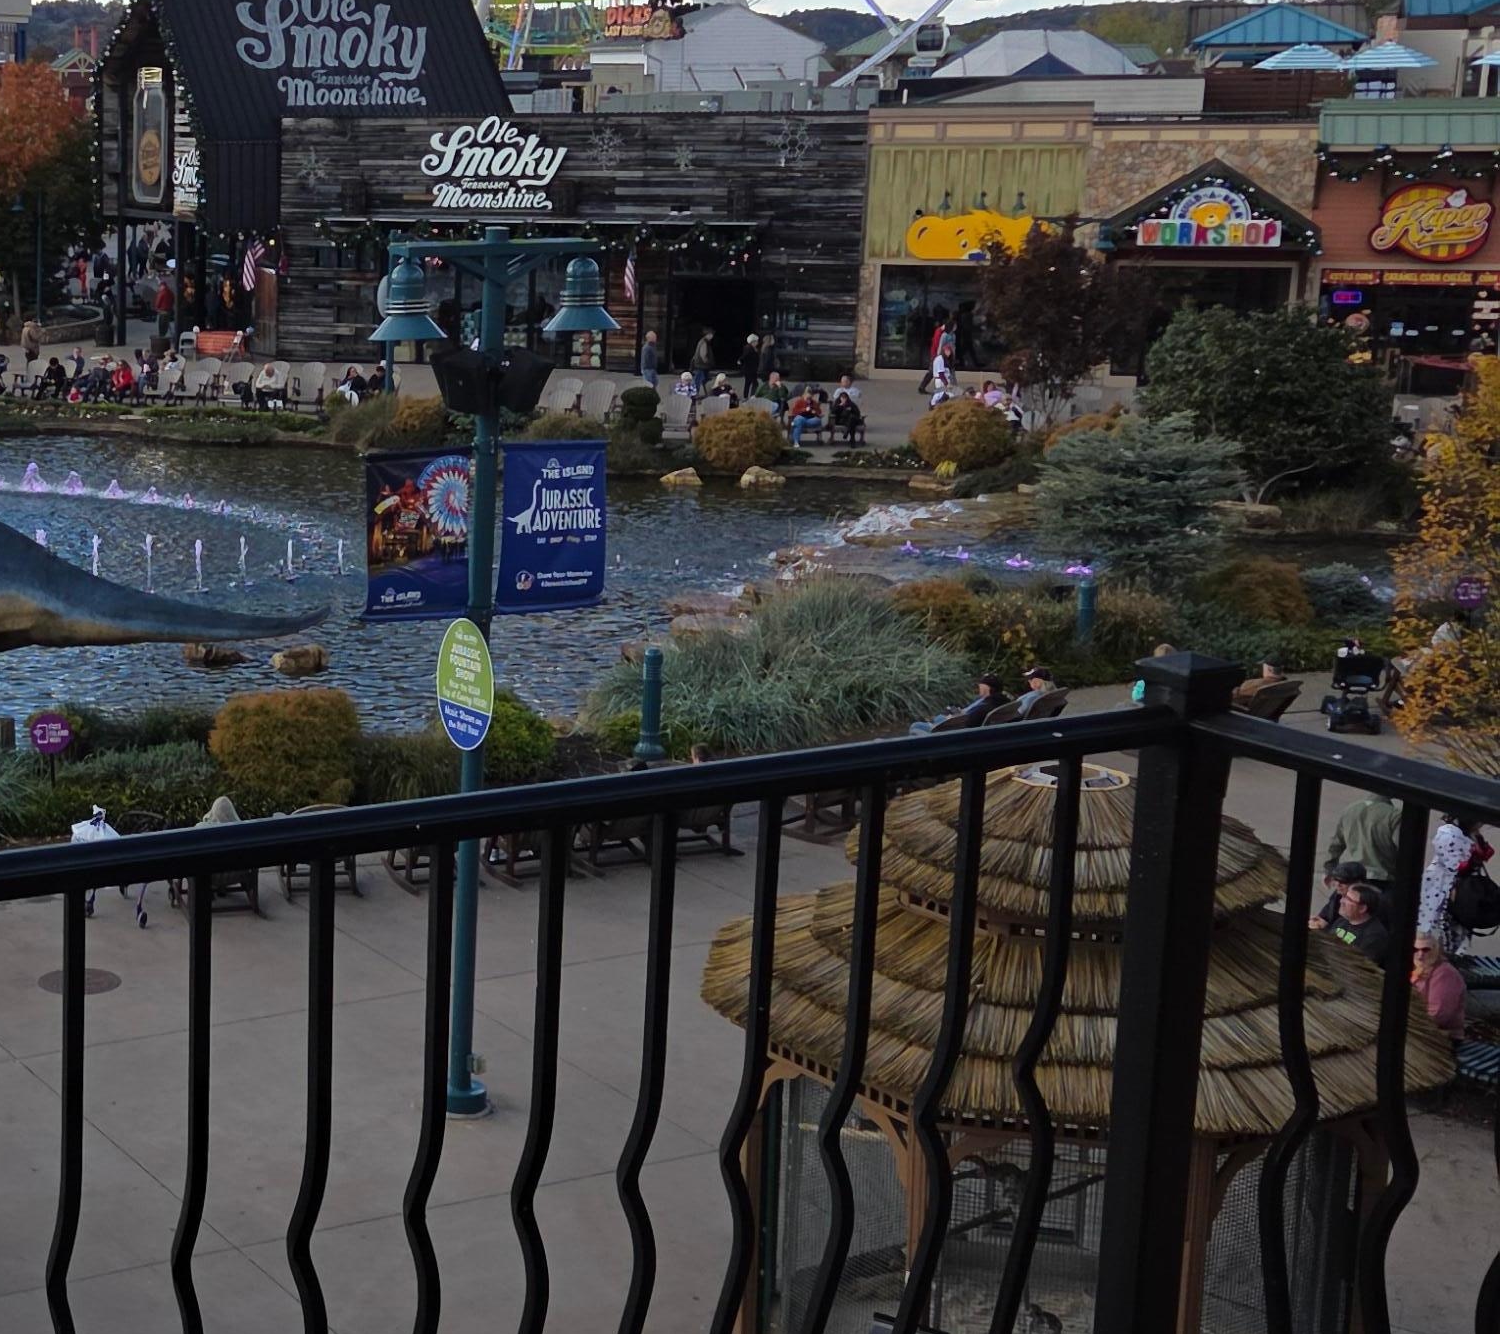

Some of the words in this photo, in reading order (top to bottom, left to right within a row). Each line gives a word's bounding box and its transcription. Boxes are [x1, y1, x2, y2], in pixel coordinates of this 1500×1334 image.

[312, 70, 371, 85] Tennessee
[277, 76, 427, 106] Moonshine
[476, 116, 526, 146] Ole
[421, 125, 568, 187] Smoky
[461, 178, 510, 190] Tennessee
[432, 183, 552, 210] Moonshine
[1142, 220, 1278, 245] WORKSHOP
[541, 468, 560, 479] THE
[563, 465, 594, 478] ISLAND
[541, 487, 594, 510] JURASSIC
[533, 508, 601, 532] ADVENTURE
